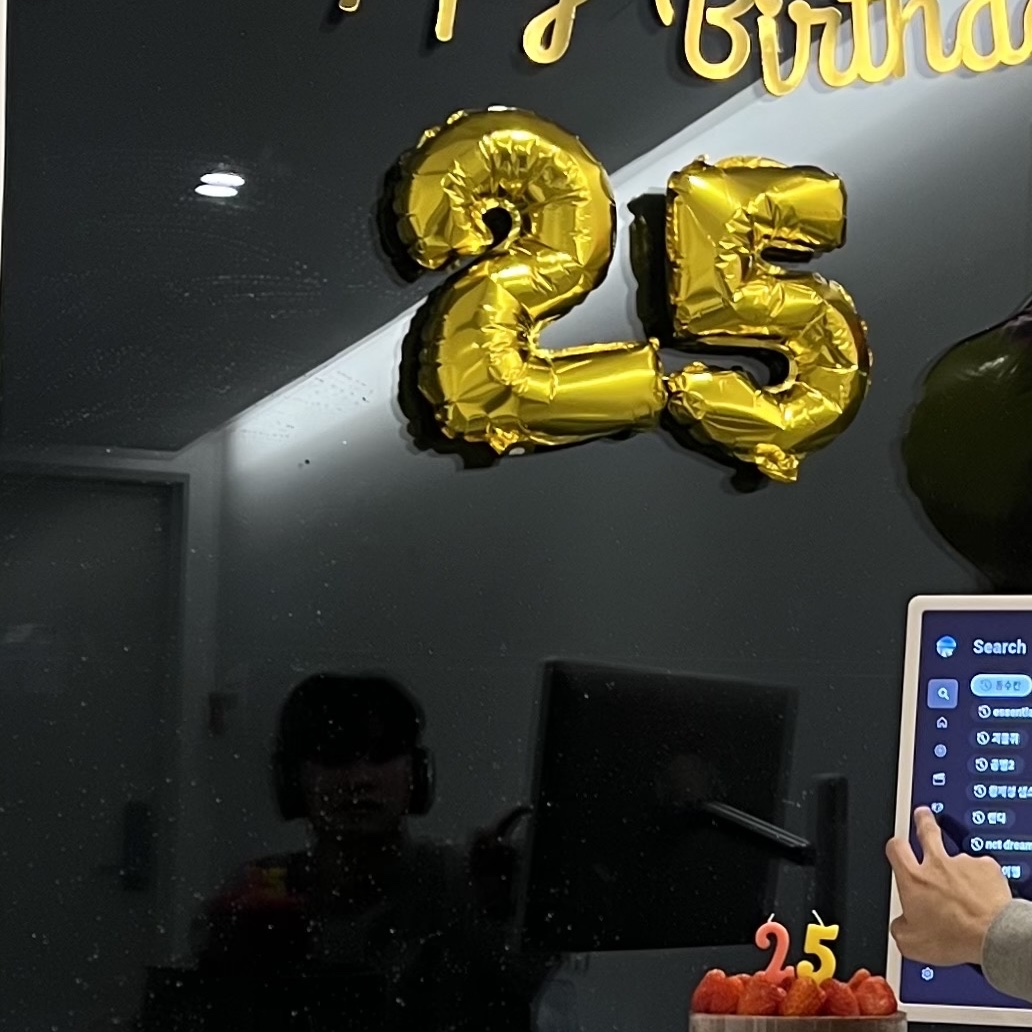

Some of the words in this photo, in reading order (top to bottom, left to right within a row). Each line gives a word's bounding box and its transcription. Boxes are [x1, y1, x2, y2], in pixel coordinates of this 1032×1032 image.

[397, 106, 872, 482] 25
[973, 638, 1027, 655] Search
[985, 840, 1002, 850] nct
[755, 921, 839, 985] 25
